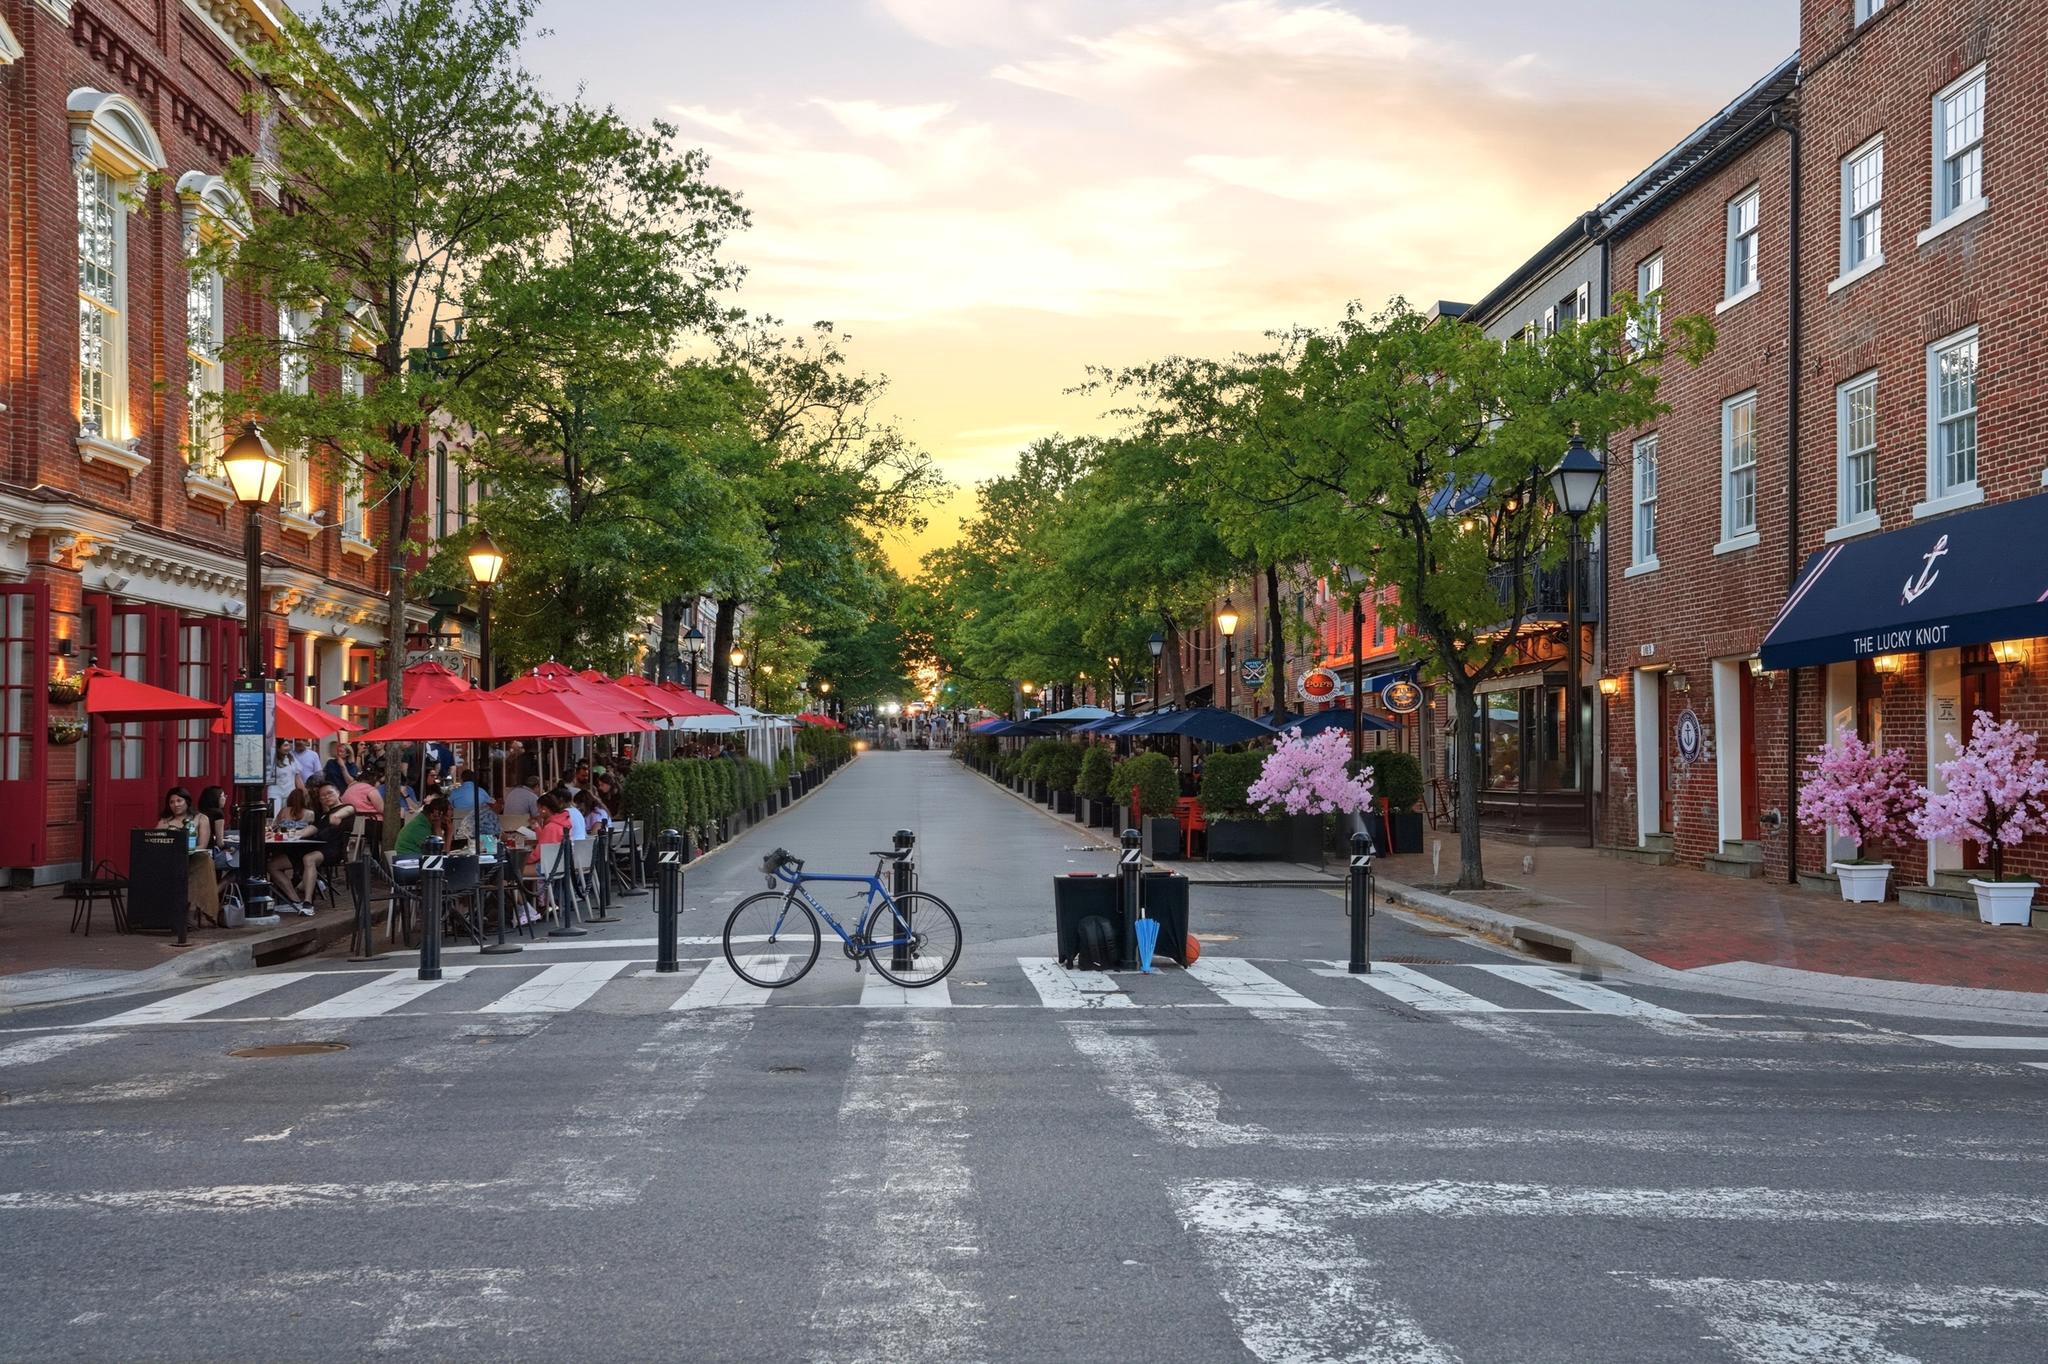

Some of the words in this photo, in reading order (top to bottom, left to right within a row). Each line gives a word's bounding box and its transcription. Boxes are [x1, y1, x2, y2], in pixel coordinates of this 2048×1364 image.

[1853, 636, 1874, 654] THE
[1877, 629, 1912, 651] LUCKY
[1915, 625, 1949, 646] KNOT
